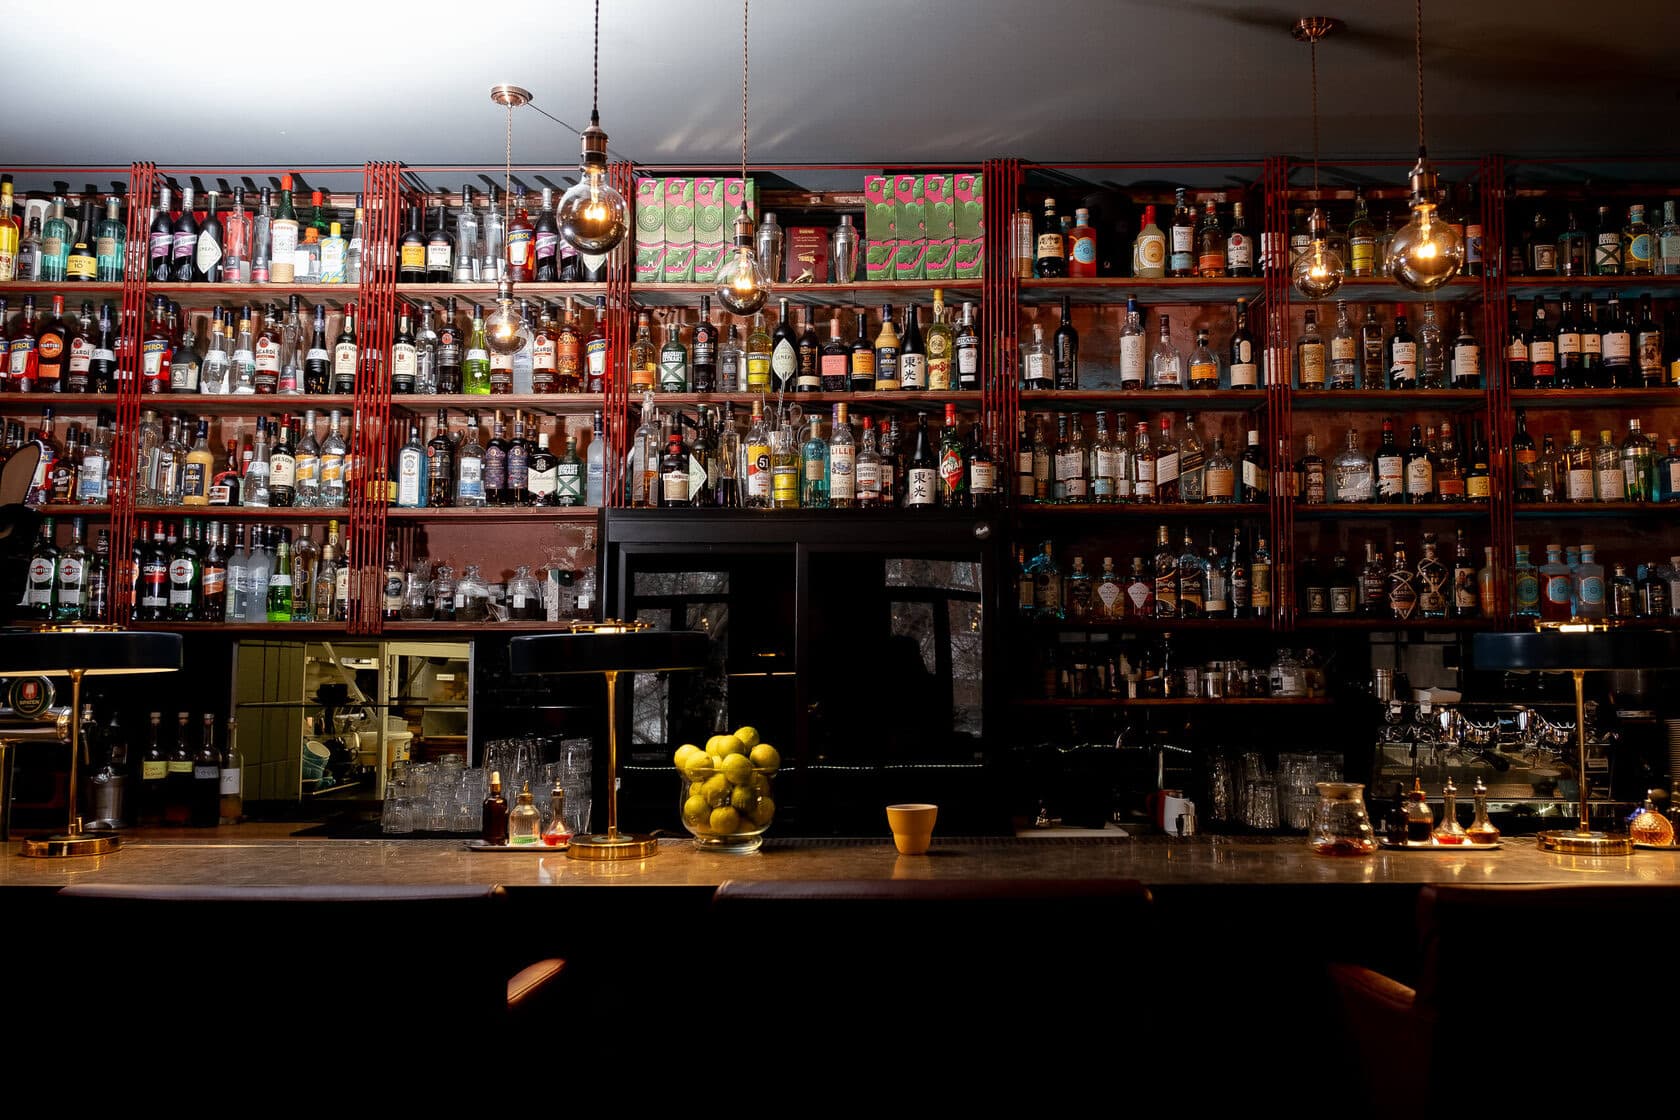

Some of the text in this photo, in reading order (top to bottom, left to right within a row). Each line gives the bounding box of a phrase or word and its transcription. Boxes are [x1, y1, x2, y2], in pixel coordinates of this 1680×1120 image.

[588, 343, 606, 352] APERO
[904, 357, 916, 380] 東光
[759, 457, 769, 468] 51
[914, 472, 926, 497] 東光
